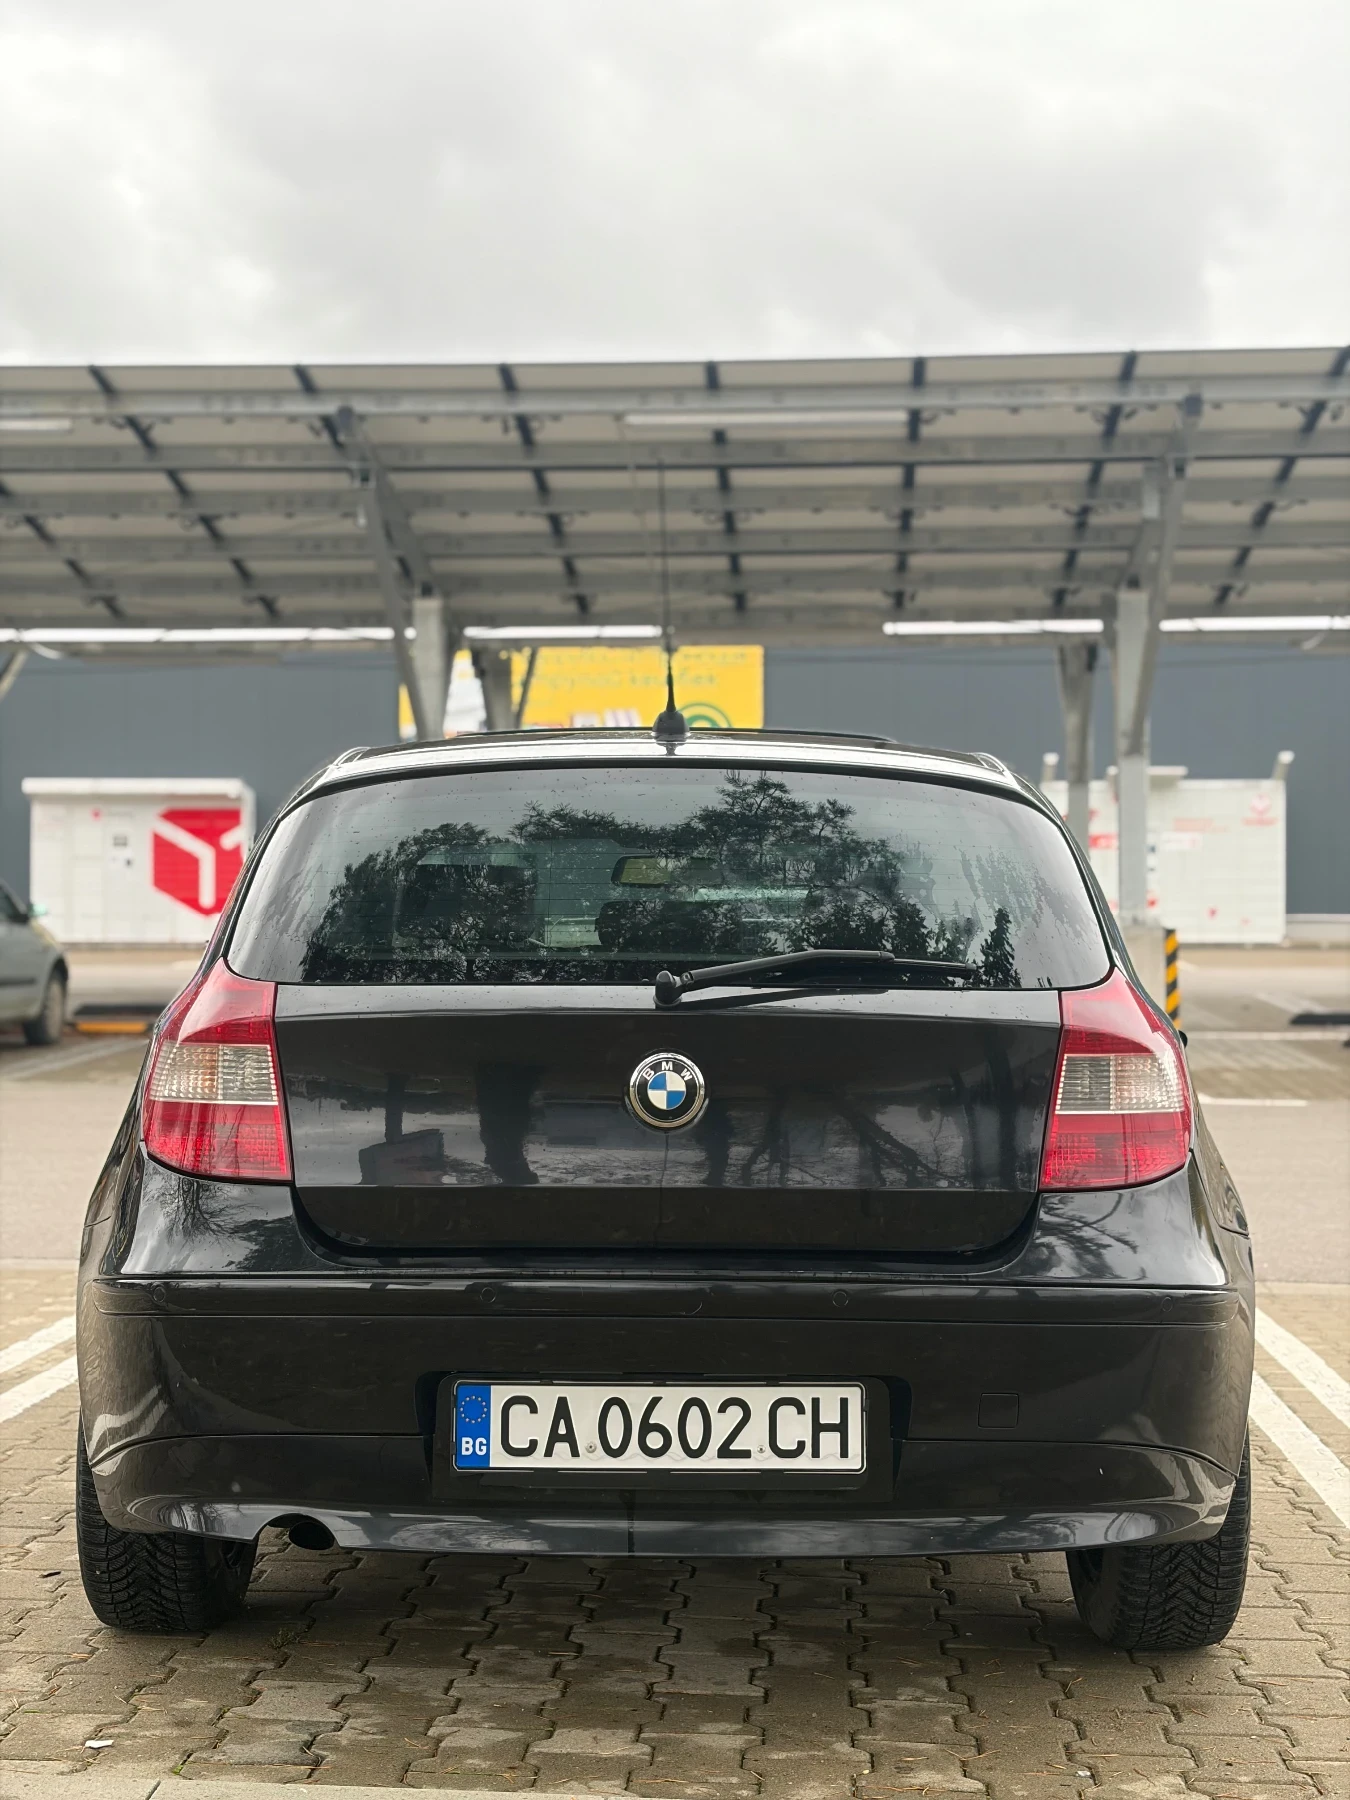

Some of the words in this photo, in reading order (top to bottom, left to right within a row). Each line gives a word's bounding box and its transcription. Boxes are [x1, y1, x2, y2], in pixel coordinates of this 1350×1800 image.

[642, 1061, 693, 1081] BMW
[500, 1395, 580, 1457] CA
[598, 1396, 752, 1459] 0602
[768, 1396, 849, 1459] CH
[461, 1437, 487, 1456] BG
